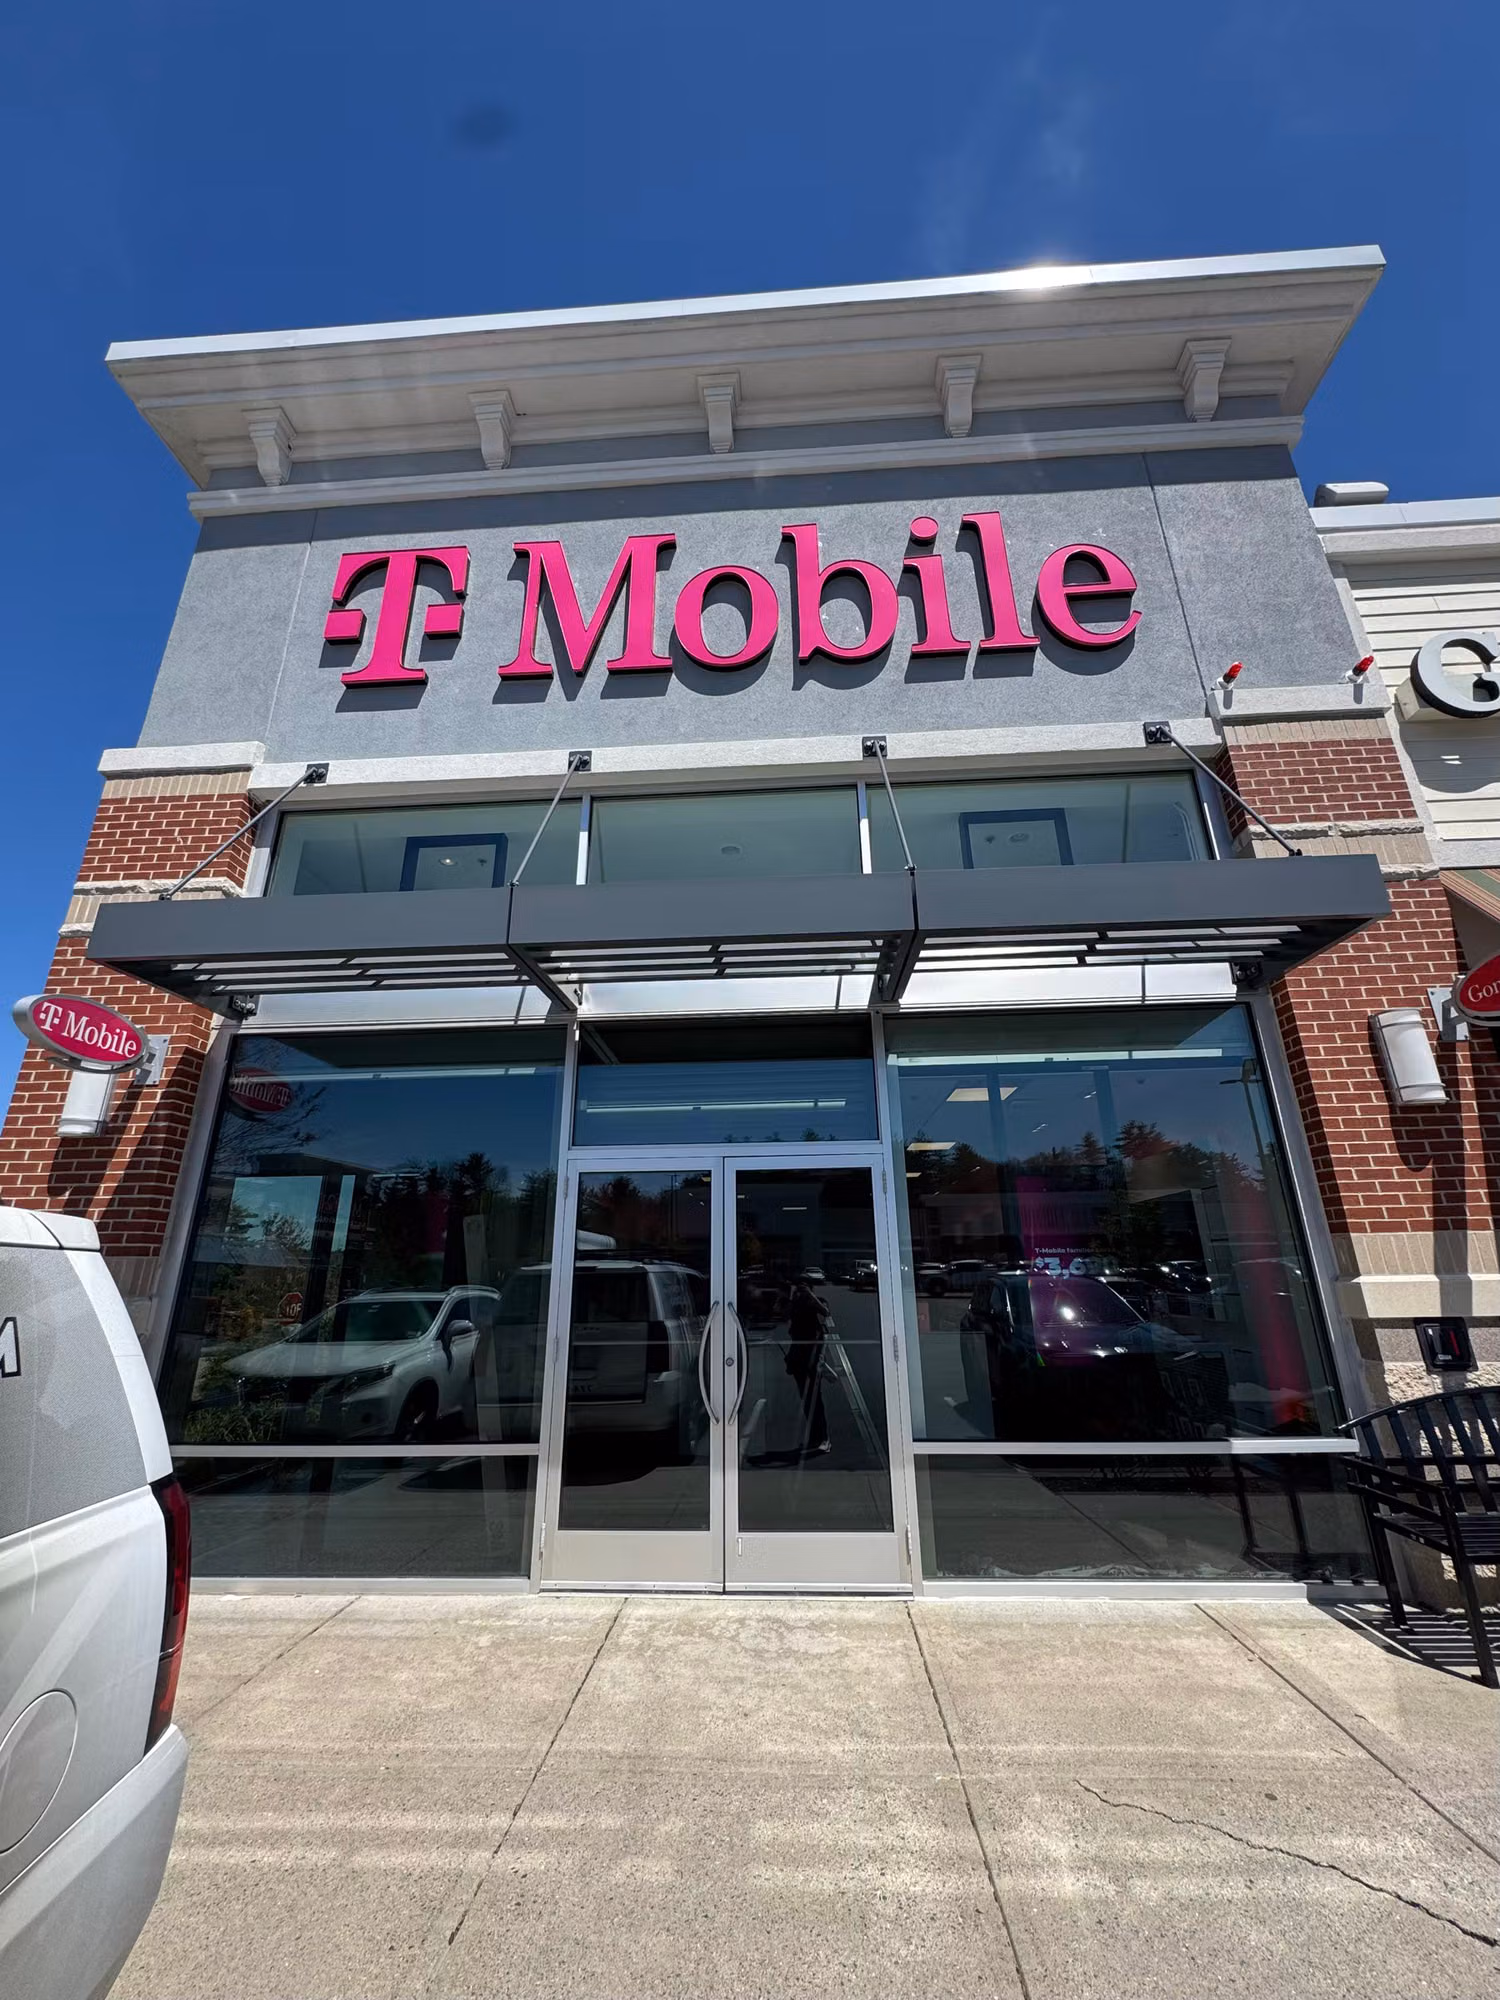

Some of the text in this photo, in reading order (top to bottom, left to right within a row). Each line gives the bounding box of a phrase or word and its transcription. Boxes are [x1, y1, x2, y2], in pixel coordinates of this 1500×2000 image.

[324, 511, 1142, 686] T Mobile
[1411, 631, 1500, 718] G
[40, 1001, 137, 1058] T Mobile
